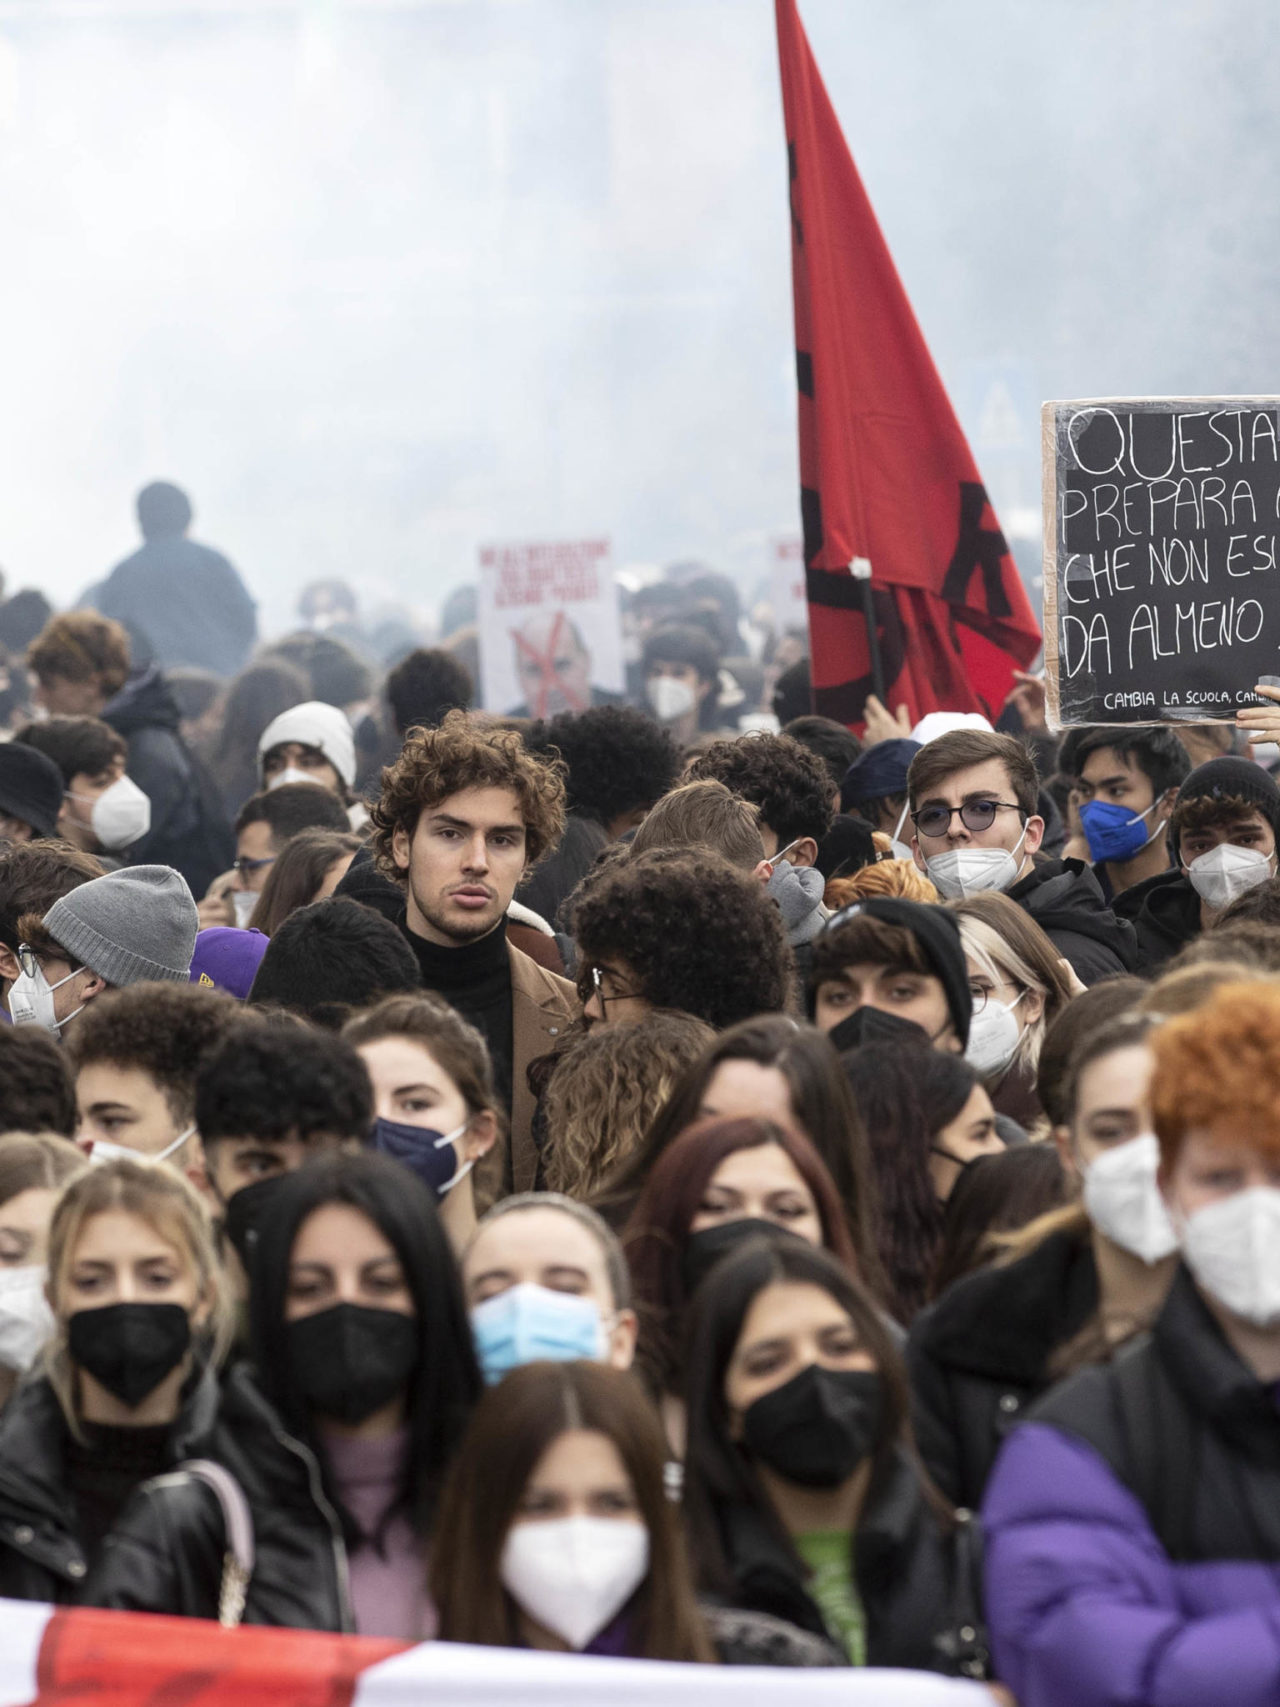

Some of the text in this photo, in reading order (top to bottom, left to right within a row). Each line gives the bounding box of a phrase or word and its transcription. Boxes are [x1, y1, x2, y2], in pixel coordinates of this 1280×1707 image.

[1068, 408, 1278, 480] QUESTA
[1062, 476, 1258, 544] PREPARA
[1064, 543, 1136, 605] CHE
[1149, 537, 1209, 587] NON
[1062, 612, 1112, 680] DA
[1129, 597, 1264, 670] ALMENO
[1104, 691, 1156, 710] CAMBIA
[1163, 690, 1181, 706] LA
[1185, 690, 1232, 705] SCUOLA,
